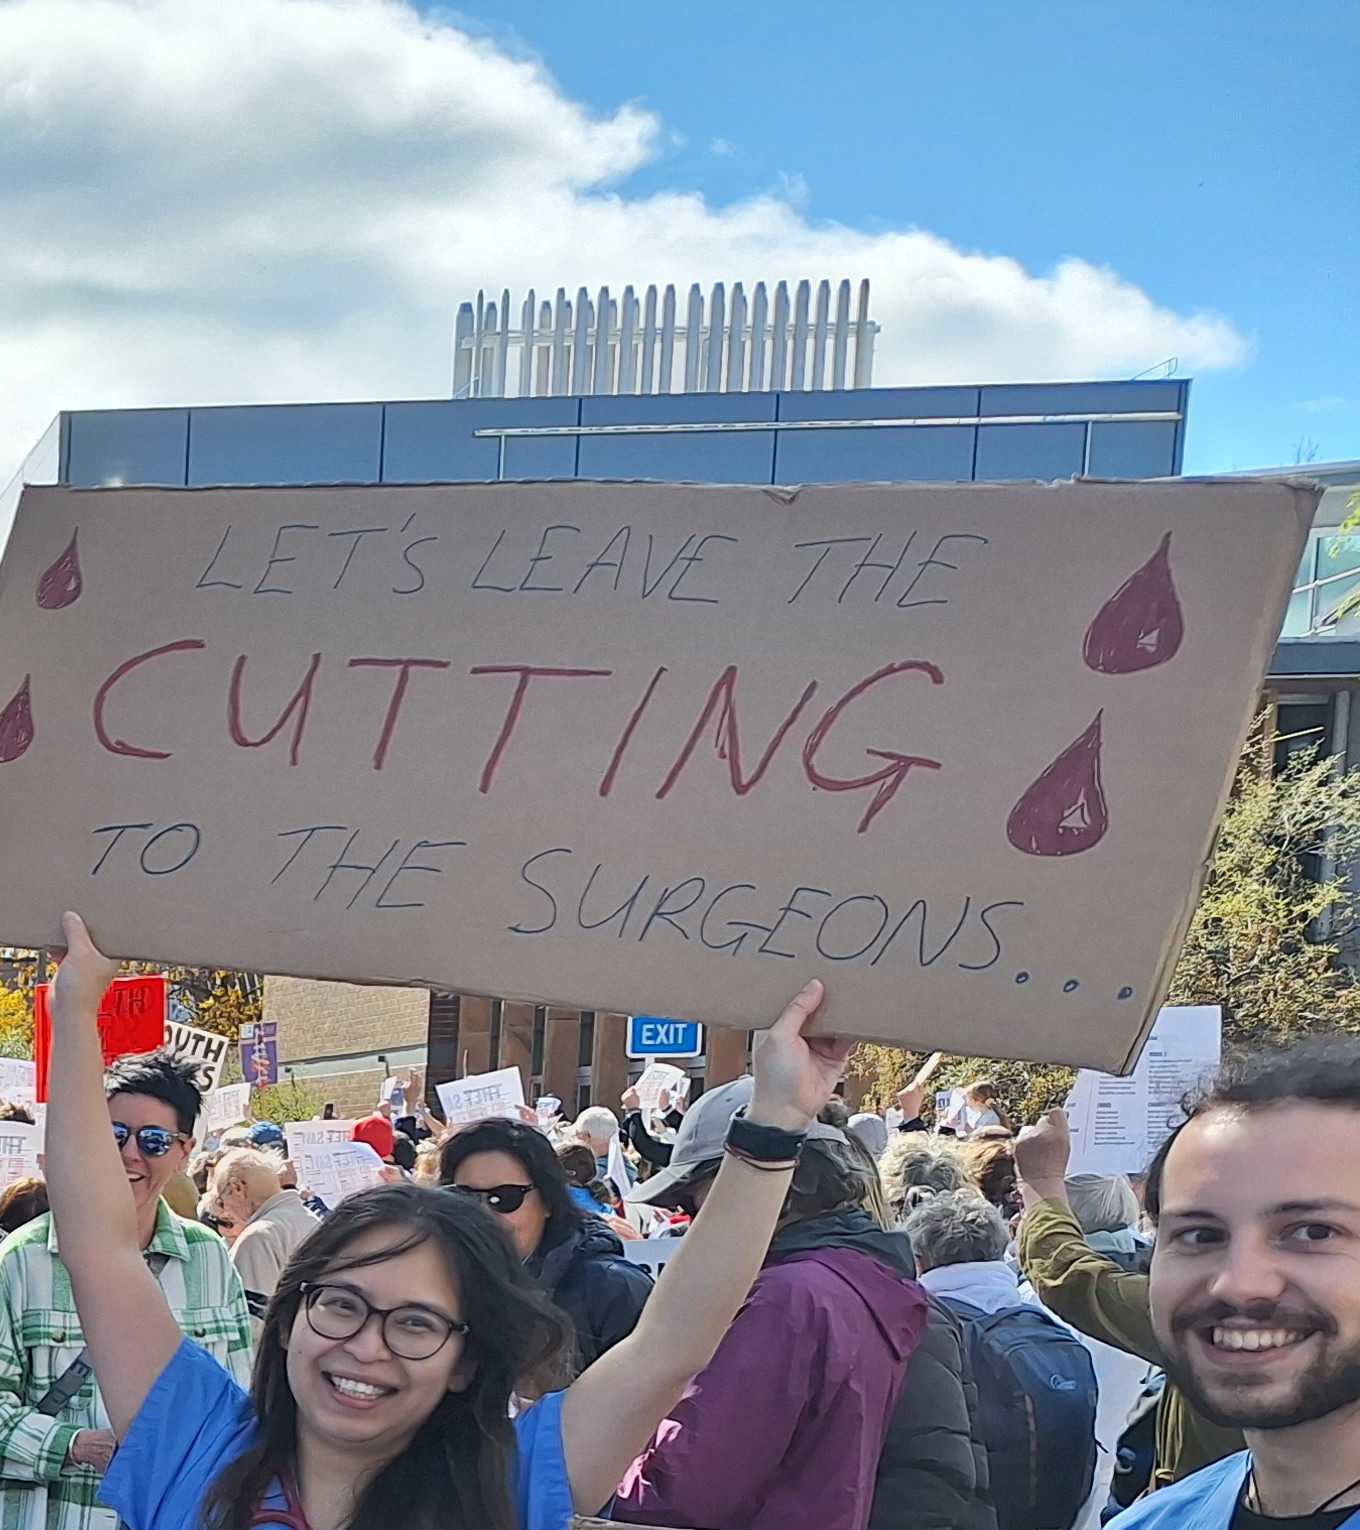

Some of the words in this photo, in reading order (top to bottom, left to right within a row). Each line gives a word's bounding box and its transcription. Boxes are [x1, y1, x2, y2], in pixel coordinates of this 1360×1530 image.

[195, 515, 431, 596] LET'S
[472, 525, 737, 604] LEAVE
[795, 533, 988, 605] THE
[92, 637, 944, 833] CUTTING
[91, 822, 201, 879] TO
[269, 823, 467, 910] THE
[641, 1024, 688, 1046] EXIT
